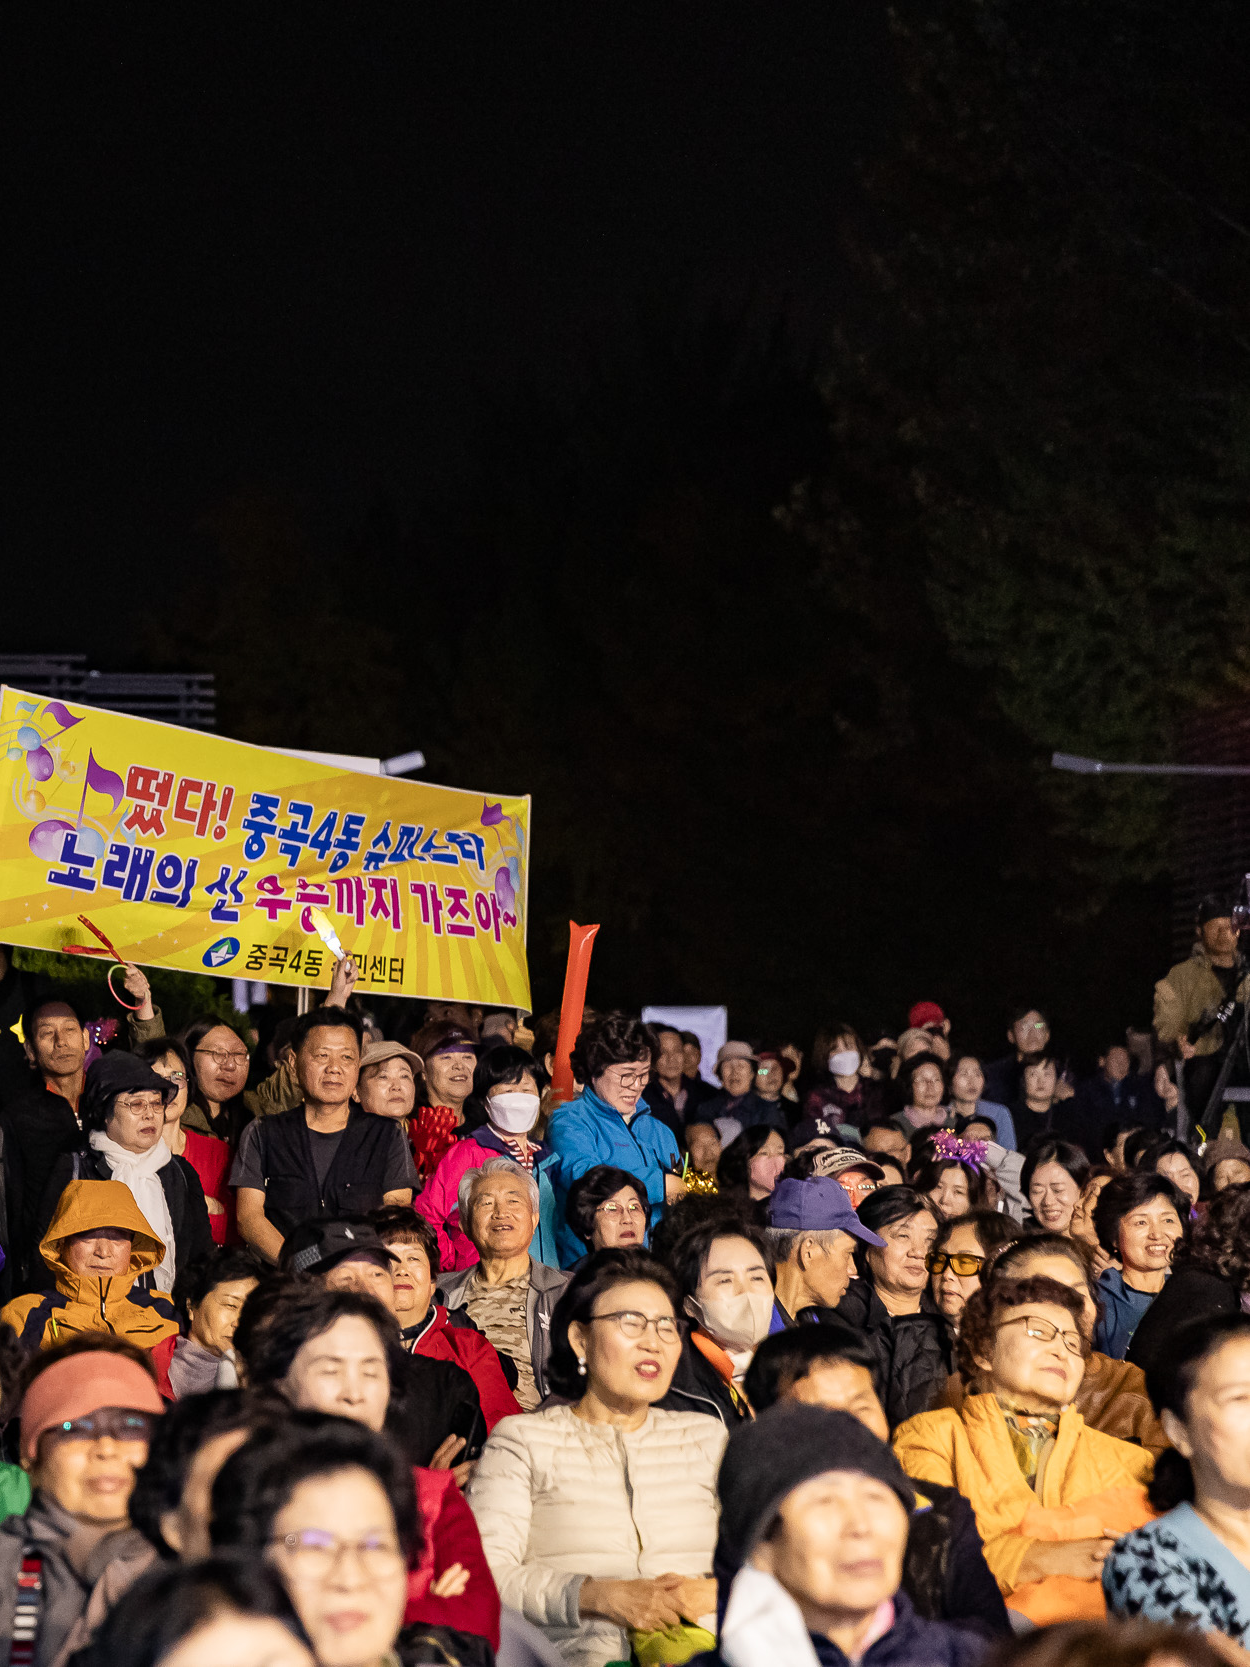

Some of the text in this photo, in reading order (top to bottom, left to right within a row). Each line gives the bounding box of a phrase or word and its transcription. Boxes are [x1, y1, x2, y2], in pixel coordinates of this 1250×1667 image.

[123, 765, 235, 840] 떴다!
[241, 792, 367, 874] 중곡4동
[47, 831, 200, 909] 노래의
[204, 866, 249, 923] 신
[245, 943, 405, 985] 중곡4동 민센터
